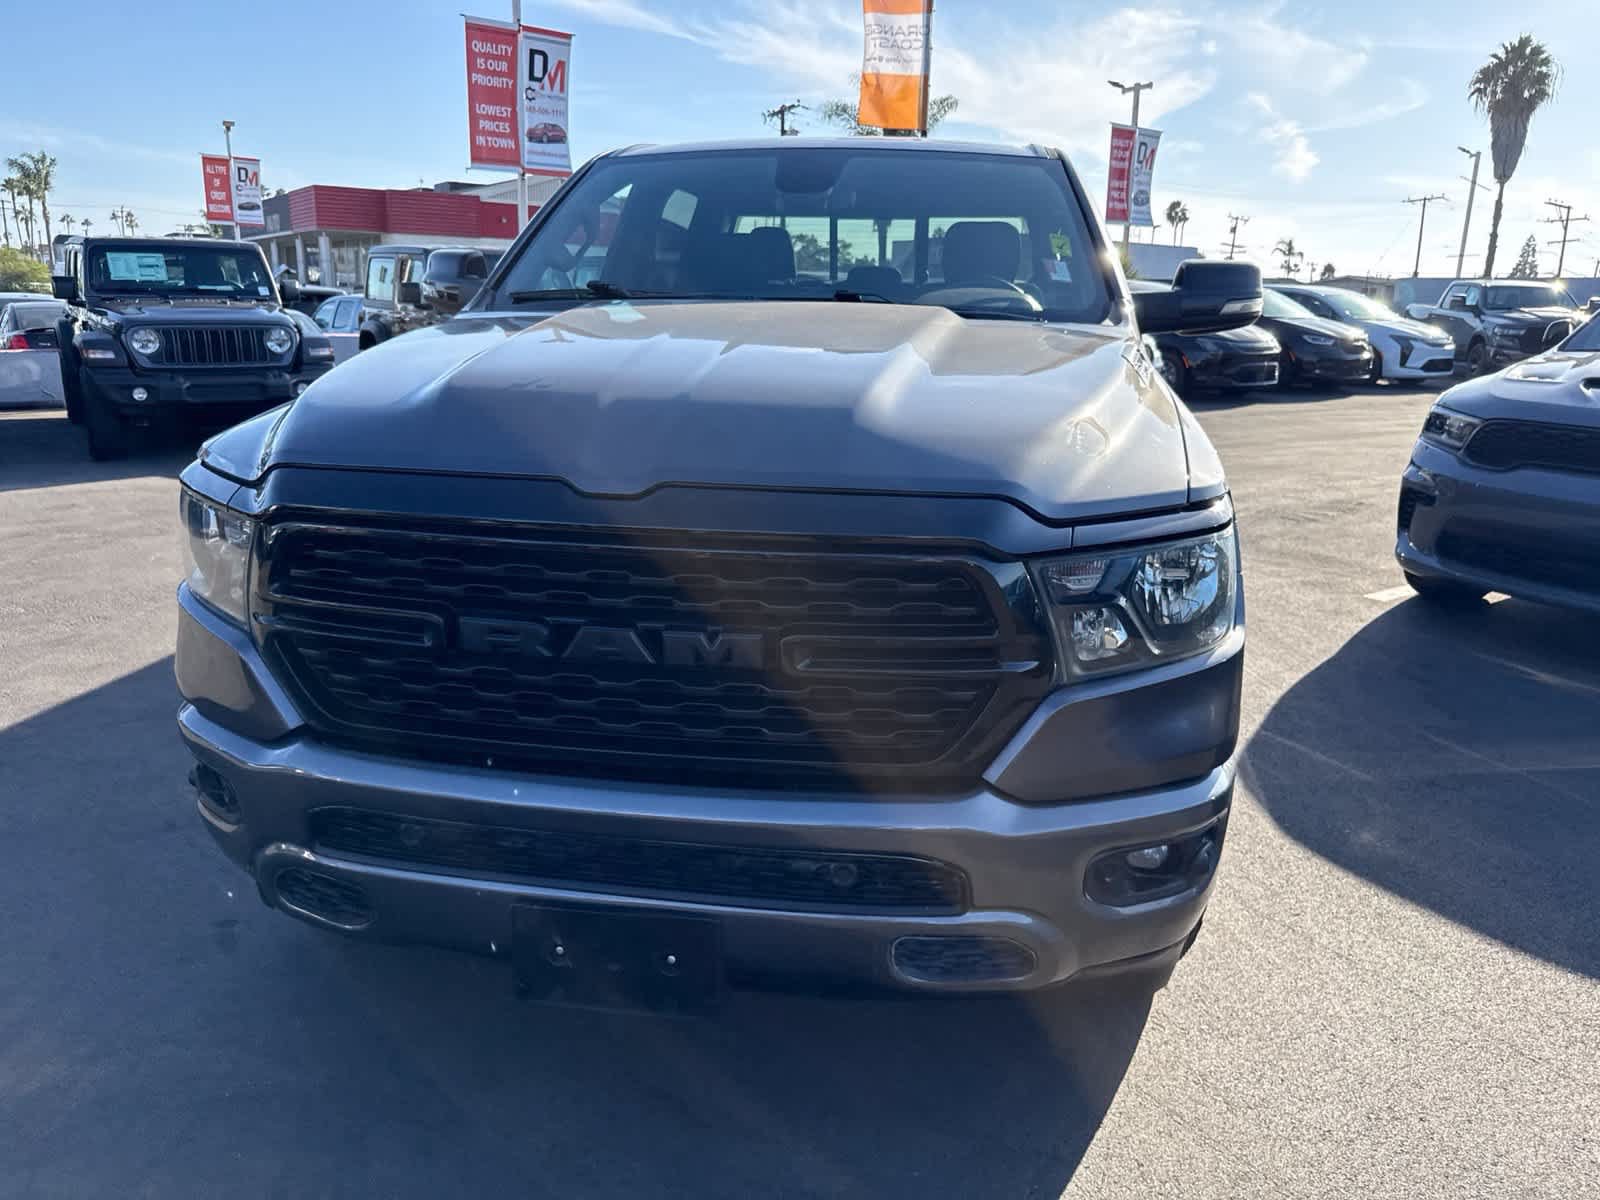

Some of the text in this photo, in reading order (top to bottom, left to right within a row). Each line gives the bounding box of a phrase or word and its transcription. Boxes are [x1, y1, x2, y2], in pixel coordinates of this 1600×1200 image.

[472, 40, 513, 57] QUALITY
[477, 58, 508, 73] IS OUR
[528, 48, 567, 94] DM
[472, 73, 514, 89] PRIORITY
[475, 103, 512, 118] LOWEST
[479, 119, 510, 133] PRICES
[476, 135, 516, 150] IN TOWN
[458, 616, 763, 668] RAM
